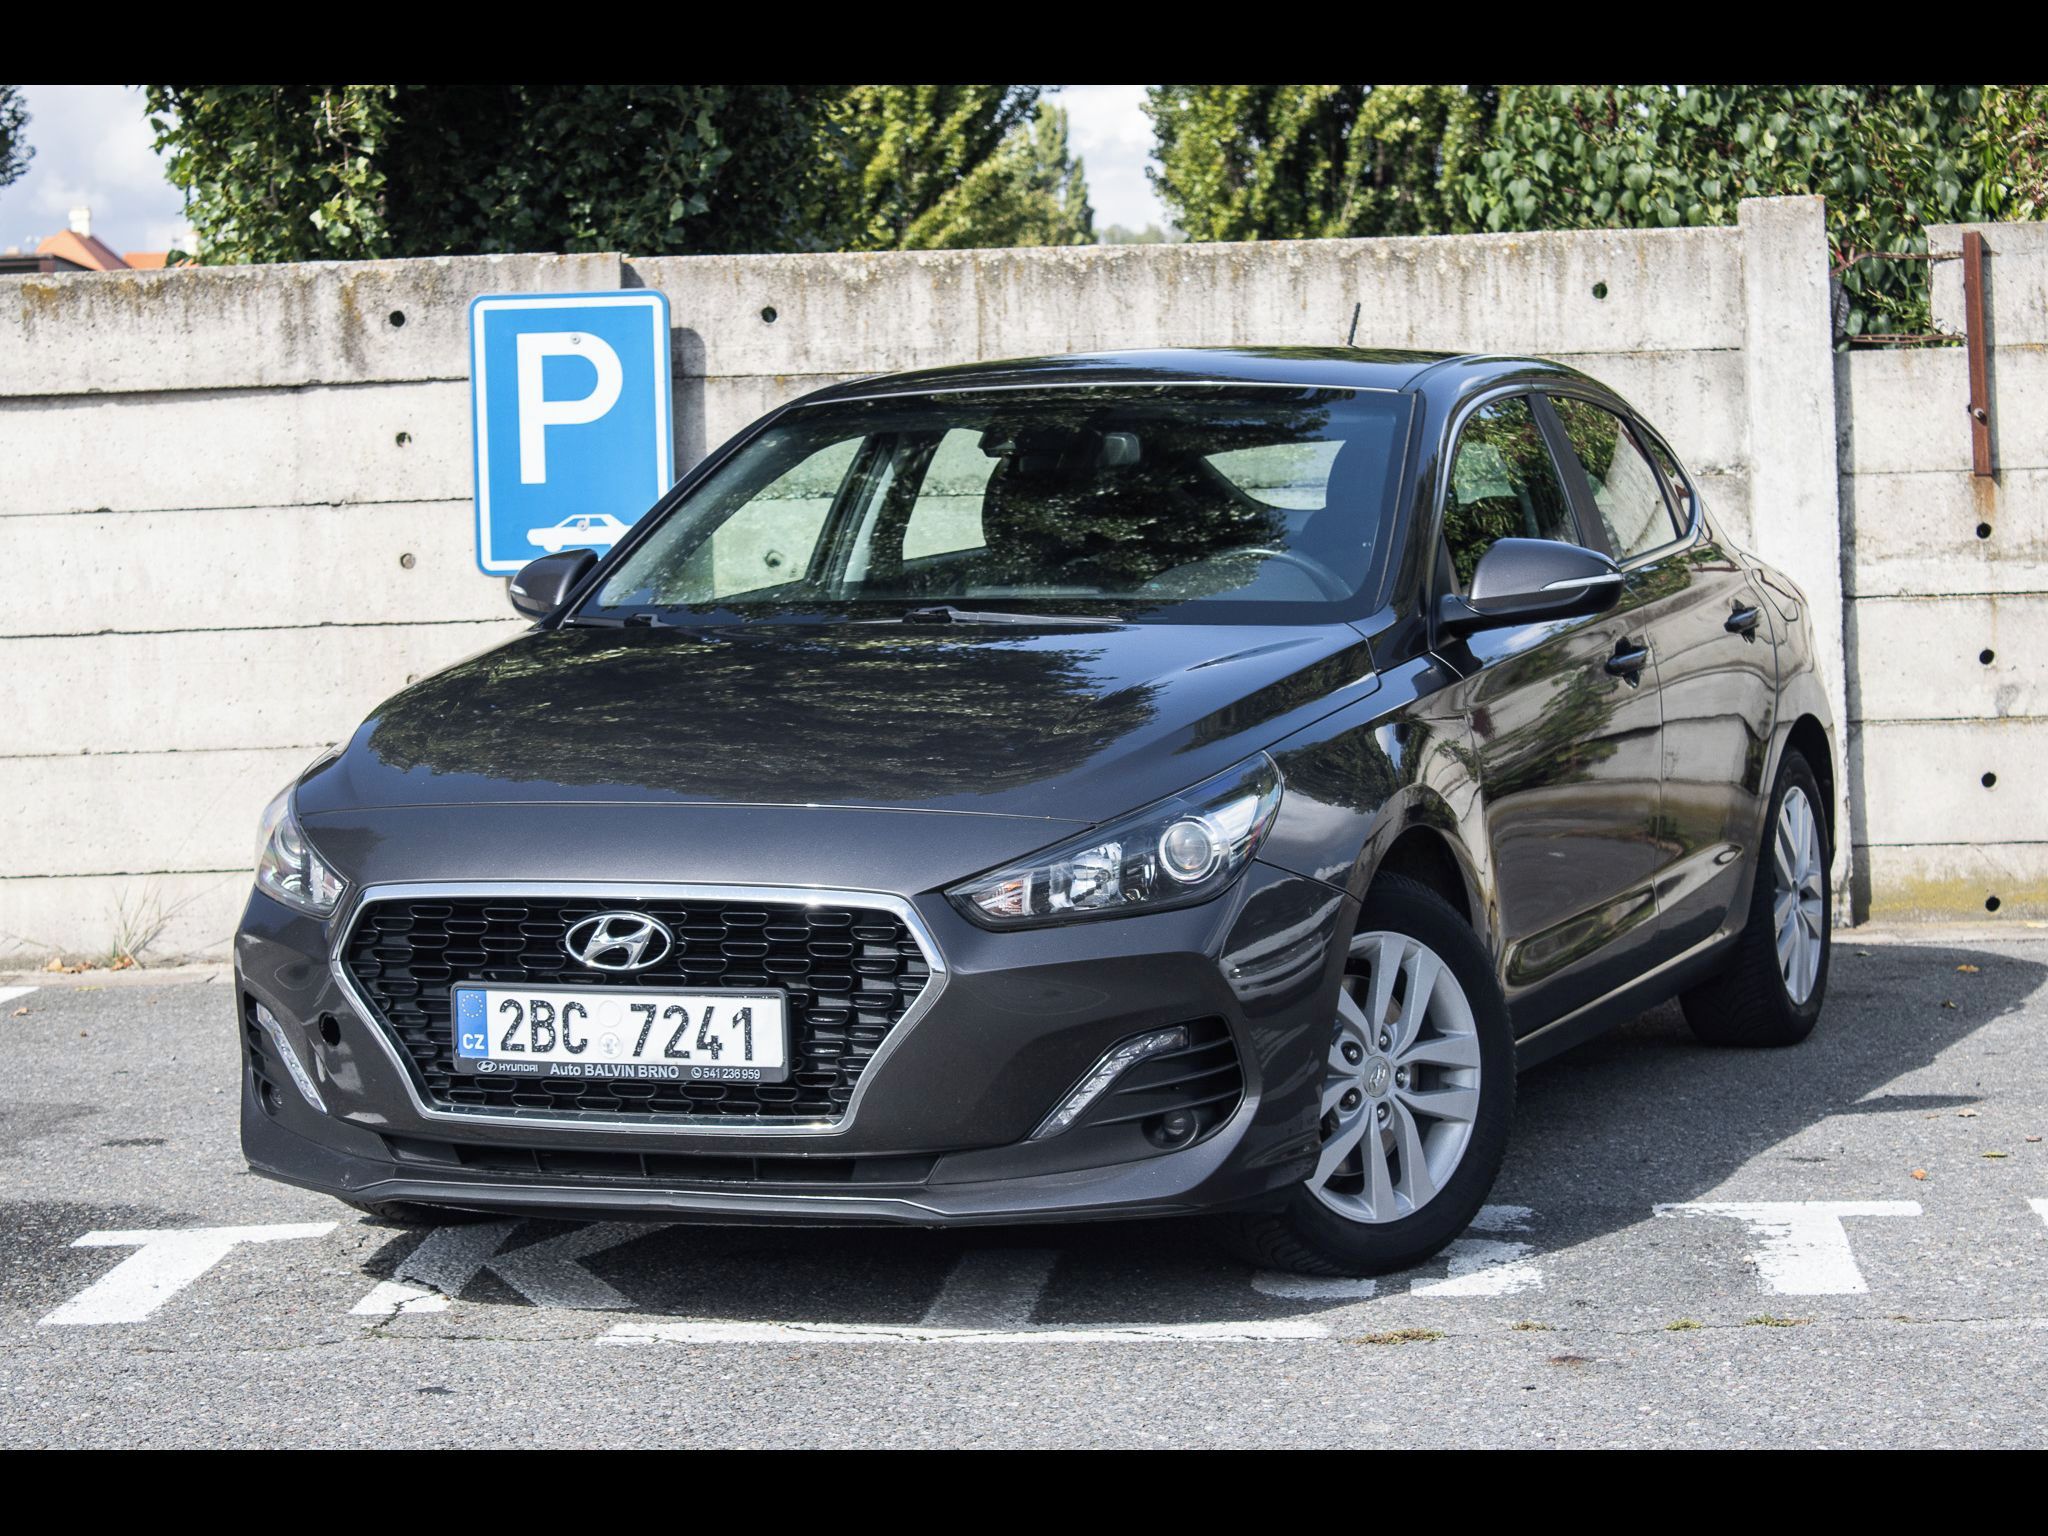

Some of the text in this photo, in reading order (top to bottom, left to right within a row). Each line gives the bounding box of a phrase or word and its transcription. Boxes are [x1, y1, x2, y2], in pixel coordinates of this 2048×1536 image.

[516, 331, 623, 484] P
[462, 1033, 485, 1050] CZ
[500, 999, 753, 1061] 2BC 7241
[499, 1063, 539, 1072] HYUNDAI
[550, 1063, 582, 1076] Auto
[584, 1063, 635, 1077] BALVIN
[638, 1065, 680, 1078] BRNO
